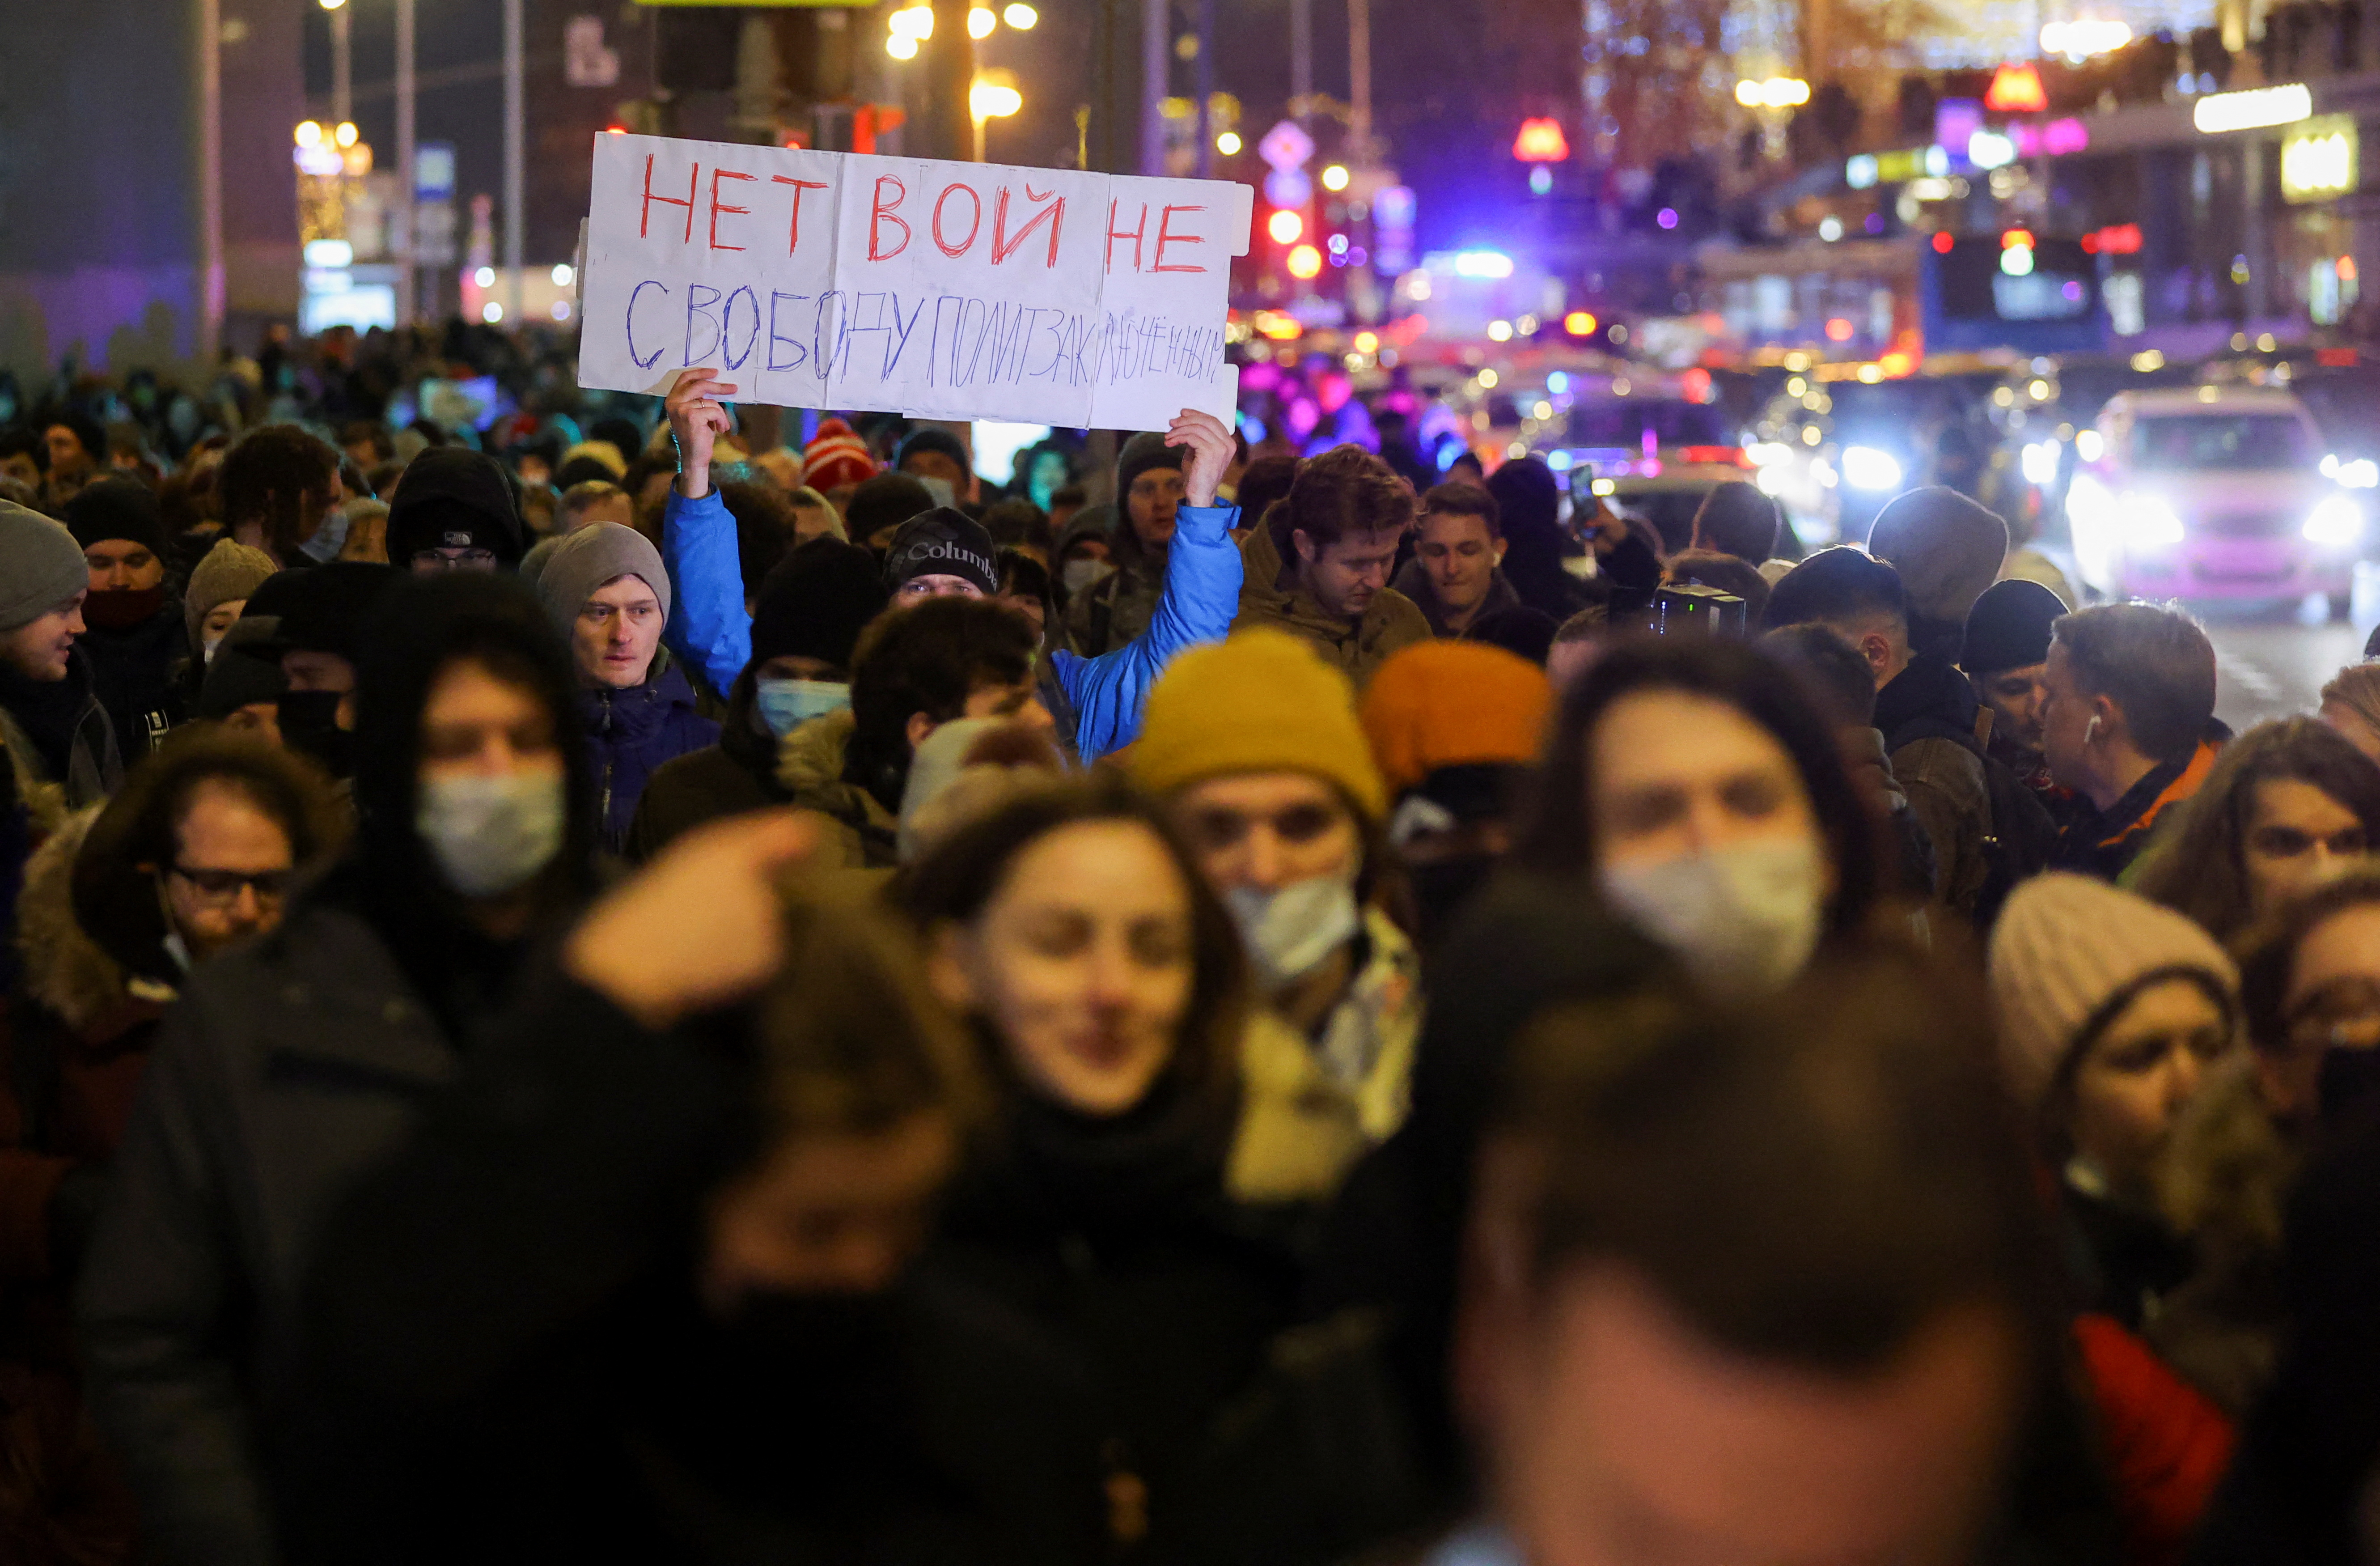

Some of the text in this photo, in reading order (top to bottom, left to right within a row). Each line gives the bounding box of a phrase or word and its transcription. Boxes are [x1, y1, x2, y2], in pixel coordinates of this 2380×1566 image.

[641, 153, 830, 258] НЕТ
[627, 280, 925, 384] СВОБОДУ
[907, 541, 997, 592] Columbia
